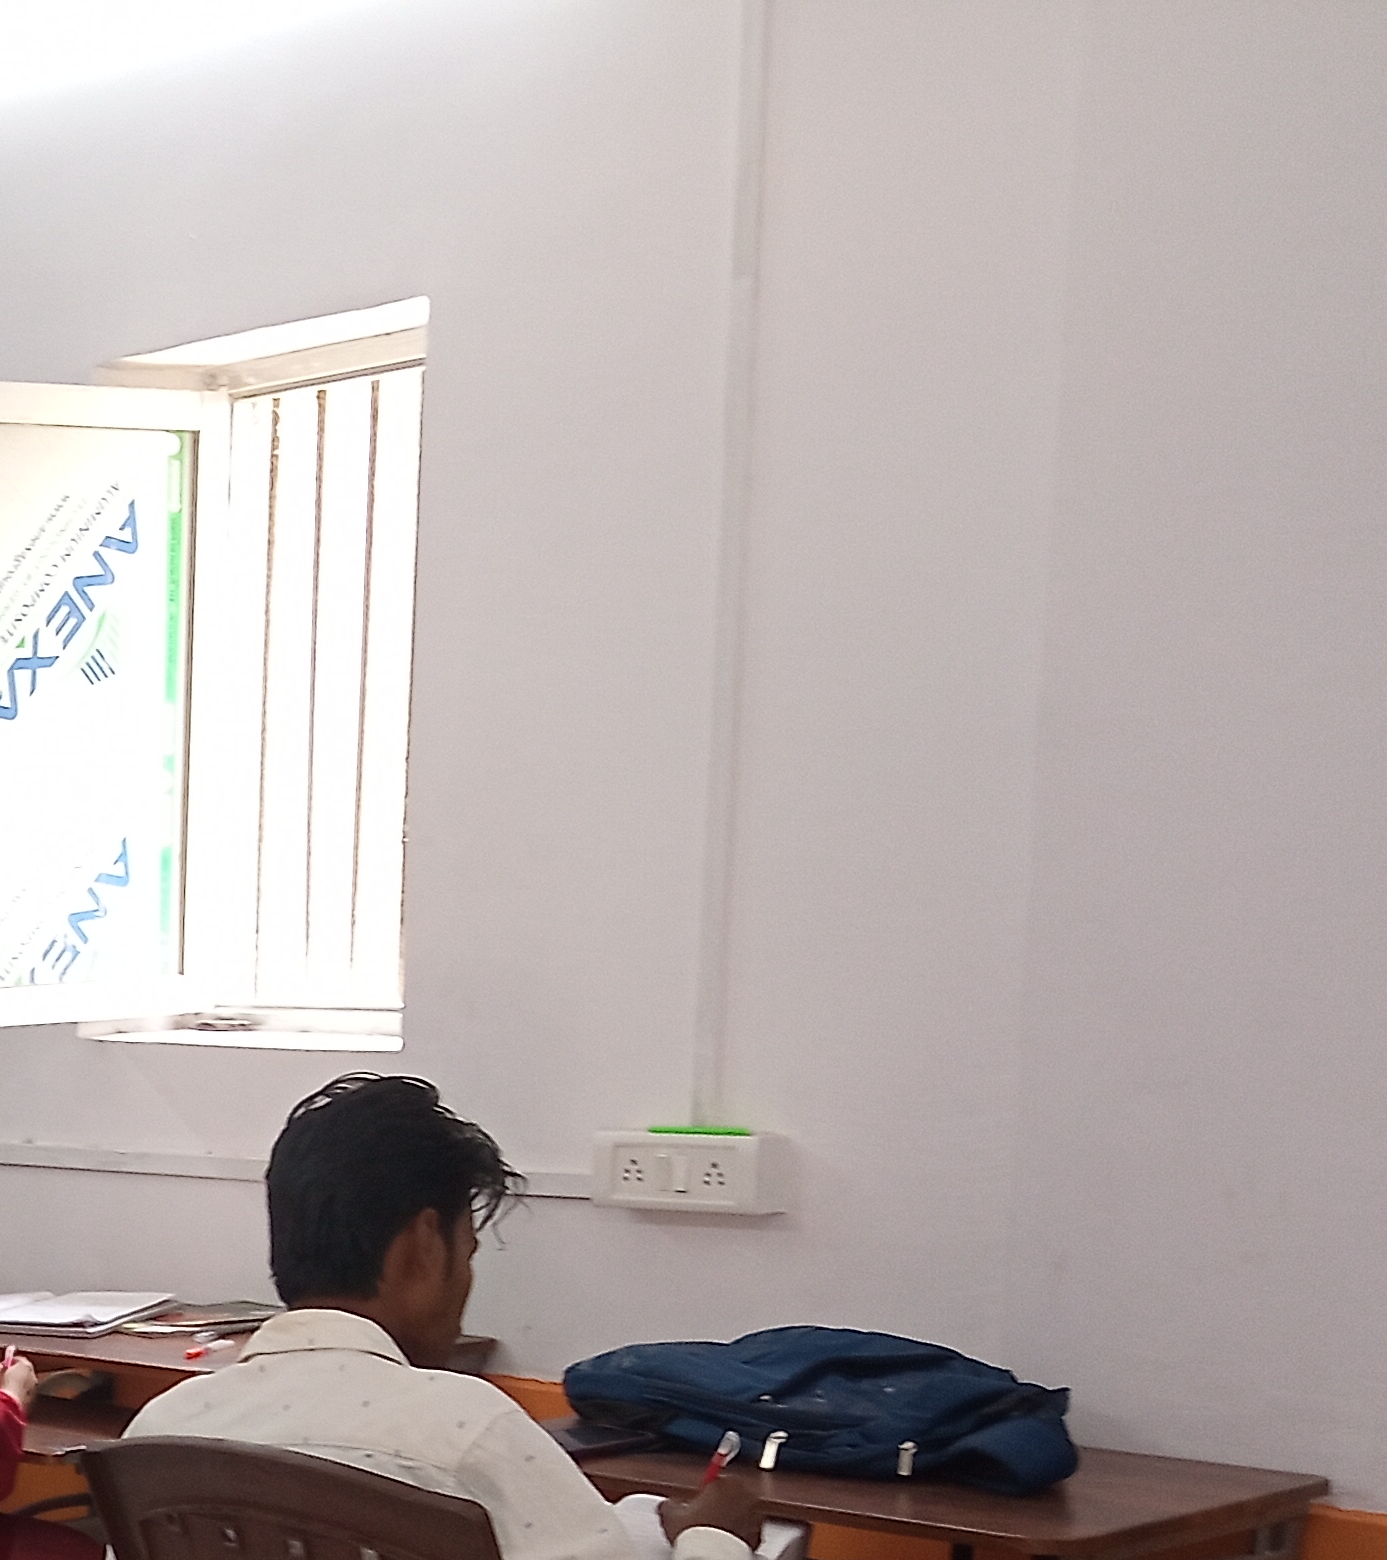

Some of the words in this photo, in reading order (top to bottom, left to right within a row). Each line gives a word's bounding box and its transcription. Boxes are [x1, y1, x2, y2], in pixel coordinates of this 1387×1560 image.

[59, 482, 121, 563] ALUMINIUM
[0, 563, 60, 645] COMPOSITE
[28, 837, 130, 985] ANE
